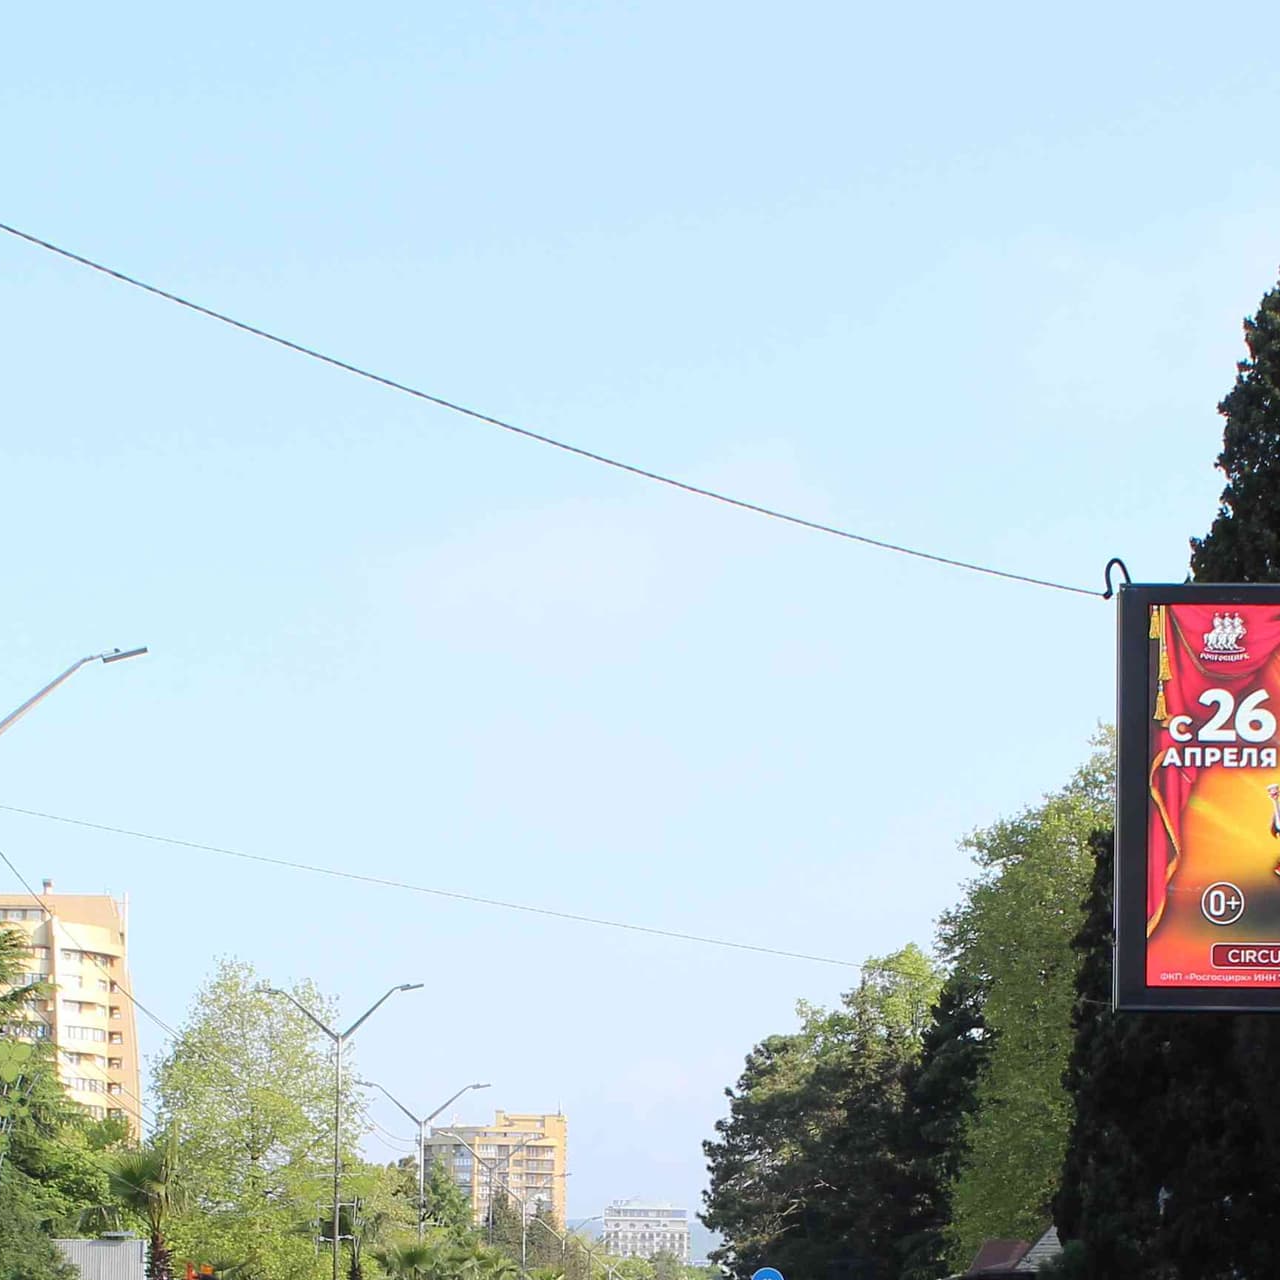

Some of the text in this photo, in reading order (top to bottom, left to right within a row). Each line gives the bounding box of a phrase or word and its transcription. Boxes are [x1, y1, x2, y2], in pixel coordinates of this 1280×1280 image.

[1197, 688, 1276, 743] 26
[1162, 748, 1276, 767] АПРЕЛЯ
[1209, 891, 1240, 916] 0+
[1254, 973, 1276, 982] ИНН
